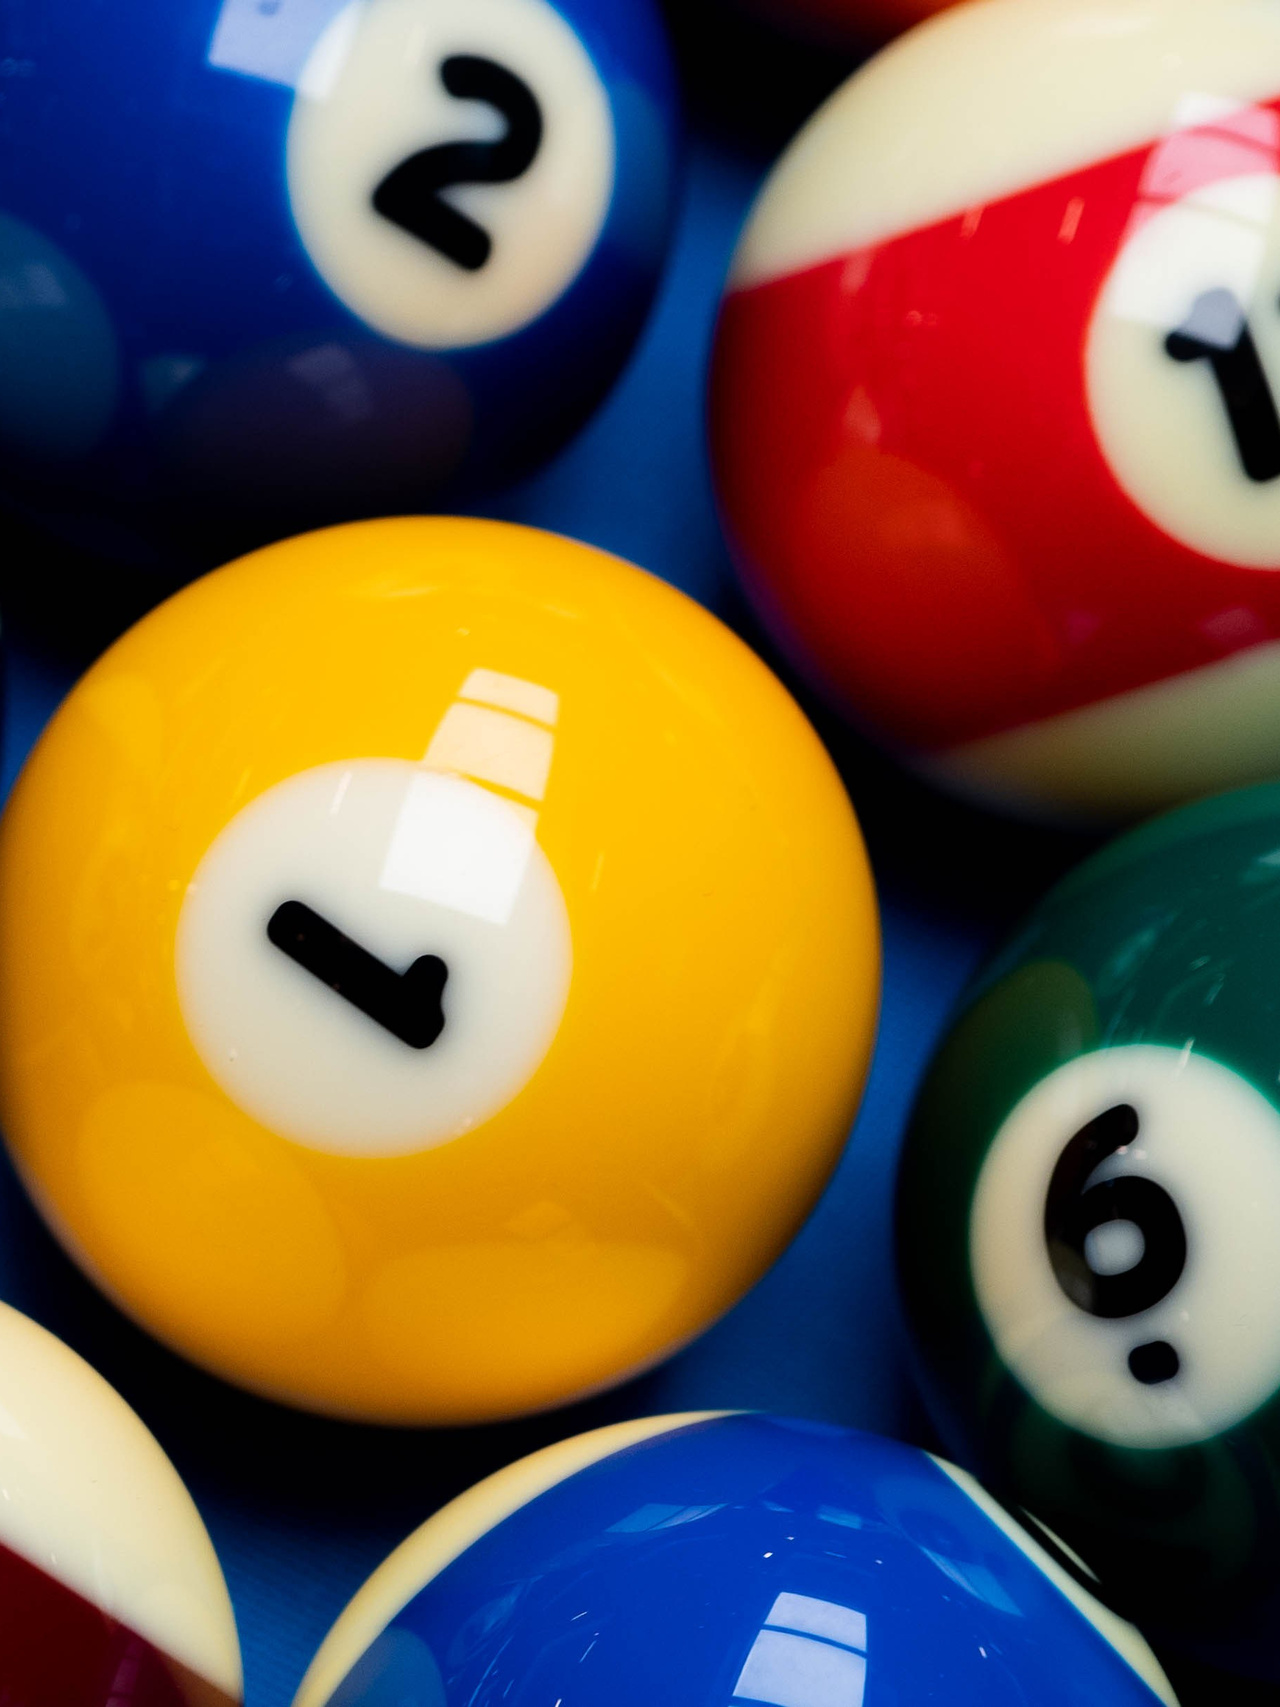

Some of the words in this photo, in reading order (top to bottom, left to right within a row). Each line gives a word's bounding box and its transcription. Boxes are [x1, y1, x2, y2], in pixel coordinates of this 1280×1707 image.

[372, 55, 543, 272] 2
[1165, 287, 1280, 483] 1
[267, 901, 448, 1049] 1
